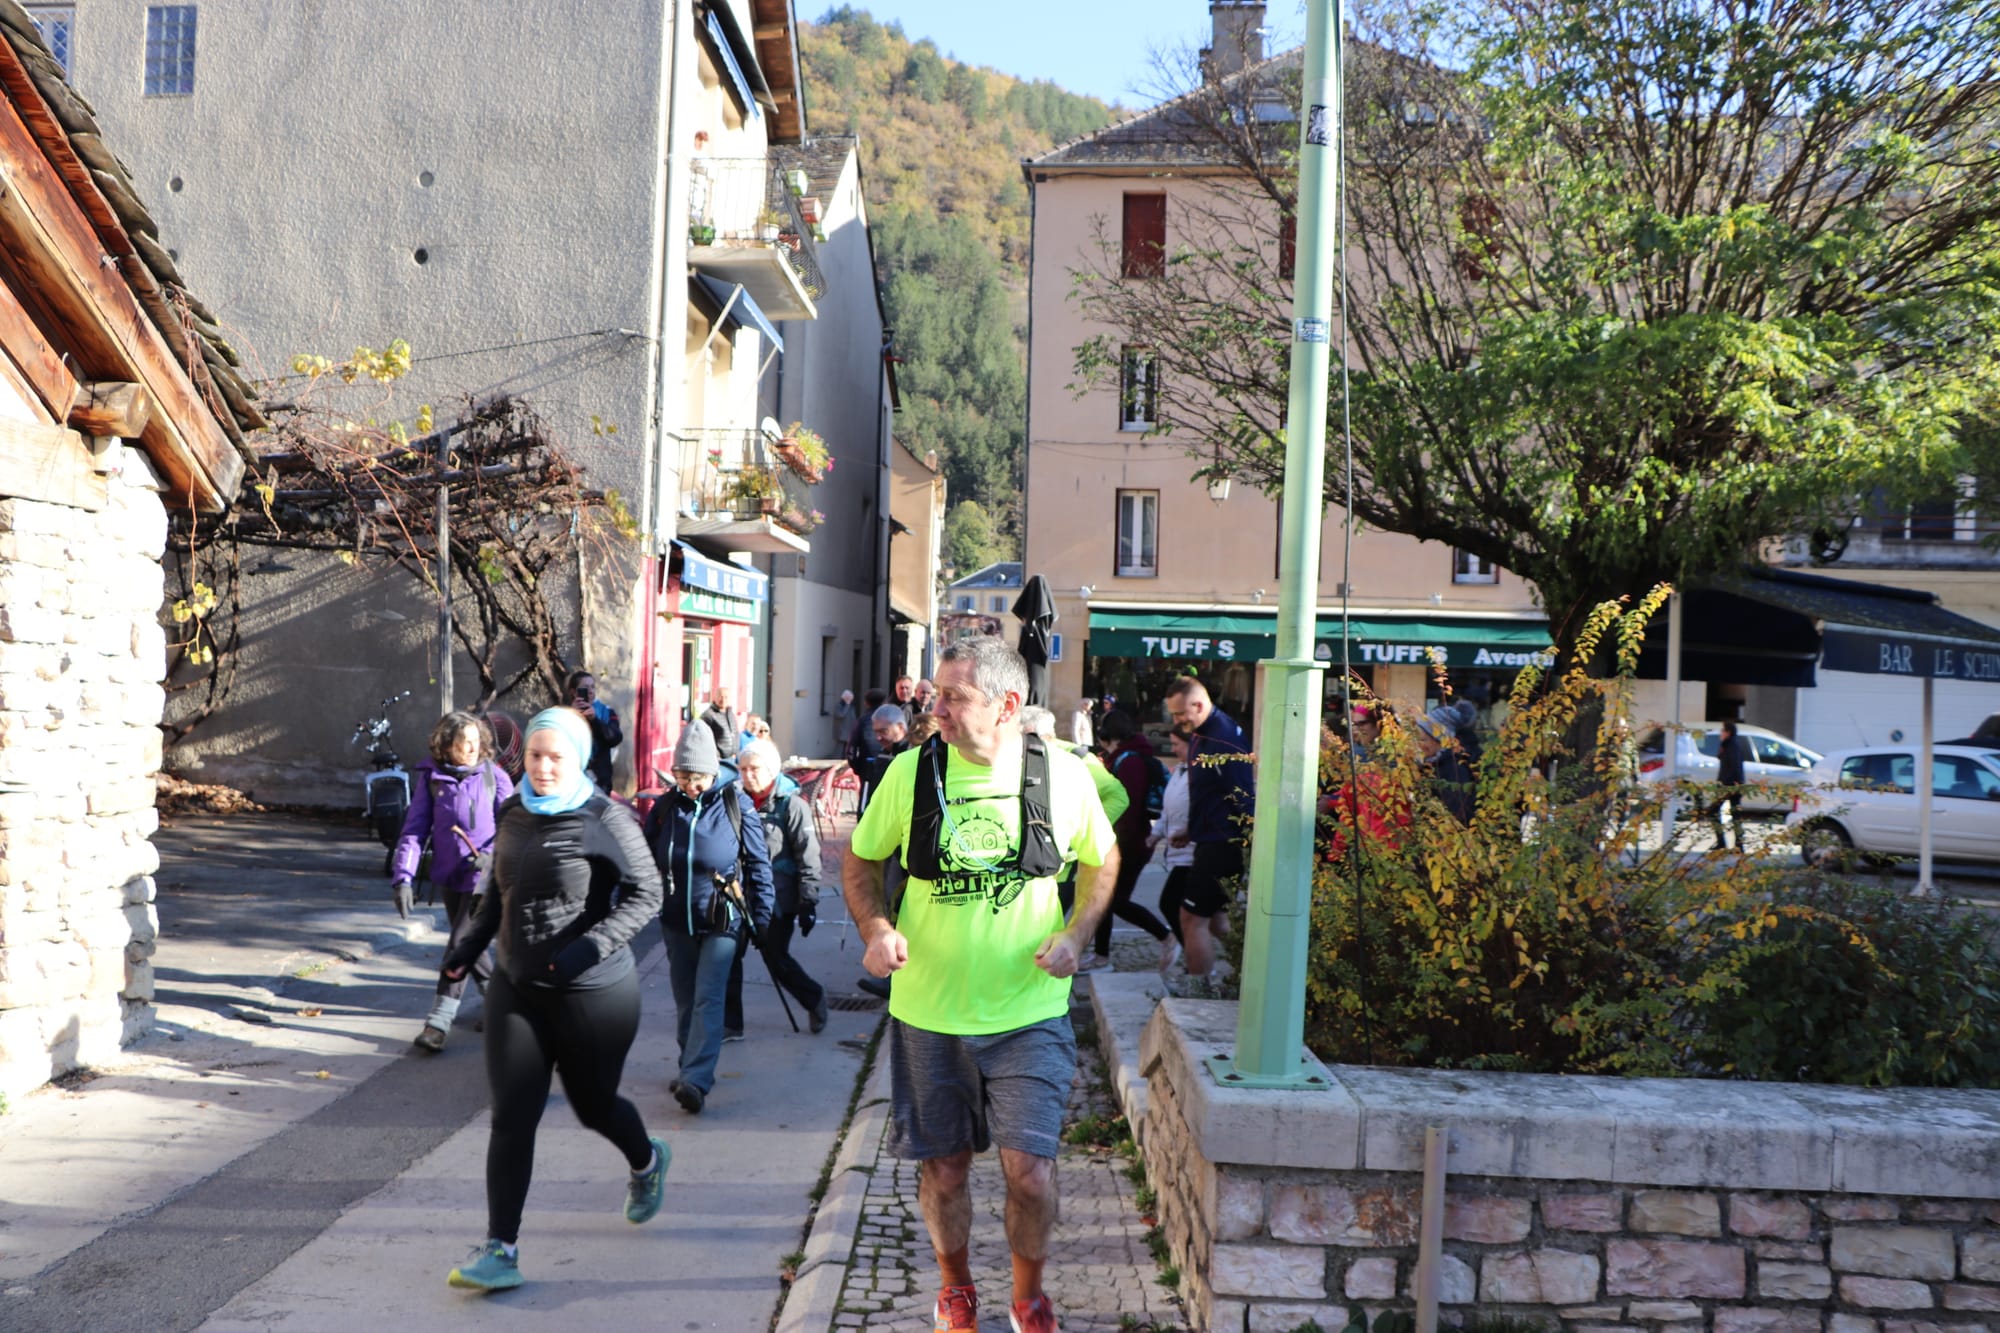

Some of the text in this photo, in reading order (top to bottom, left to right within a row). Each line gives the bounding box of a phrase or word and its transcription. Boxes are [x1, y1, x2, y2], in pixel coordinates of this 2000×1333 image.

[1142, 636, 1235, 657] TUFF'S
[1359, 643, 1448, 662] TUFFS
[1879, 643, 1914, 672] BAR
[1934, 649, 1955, 676] LE
